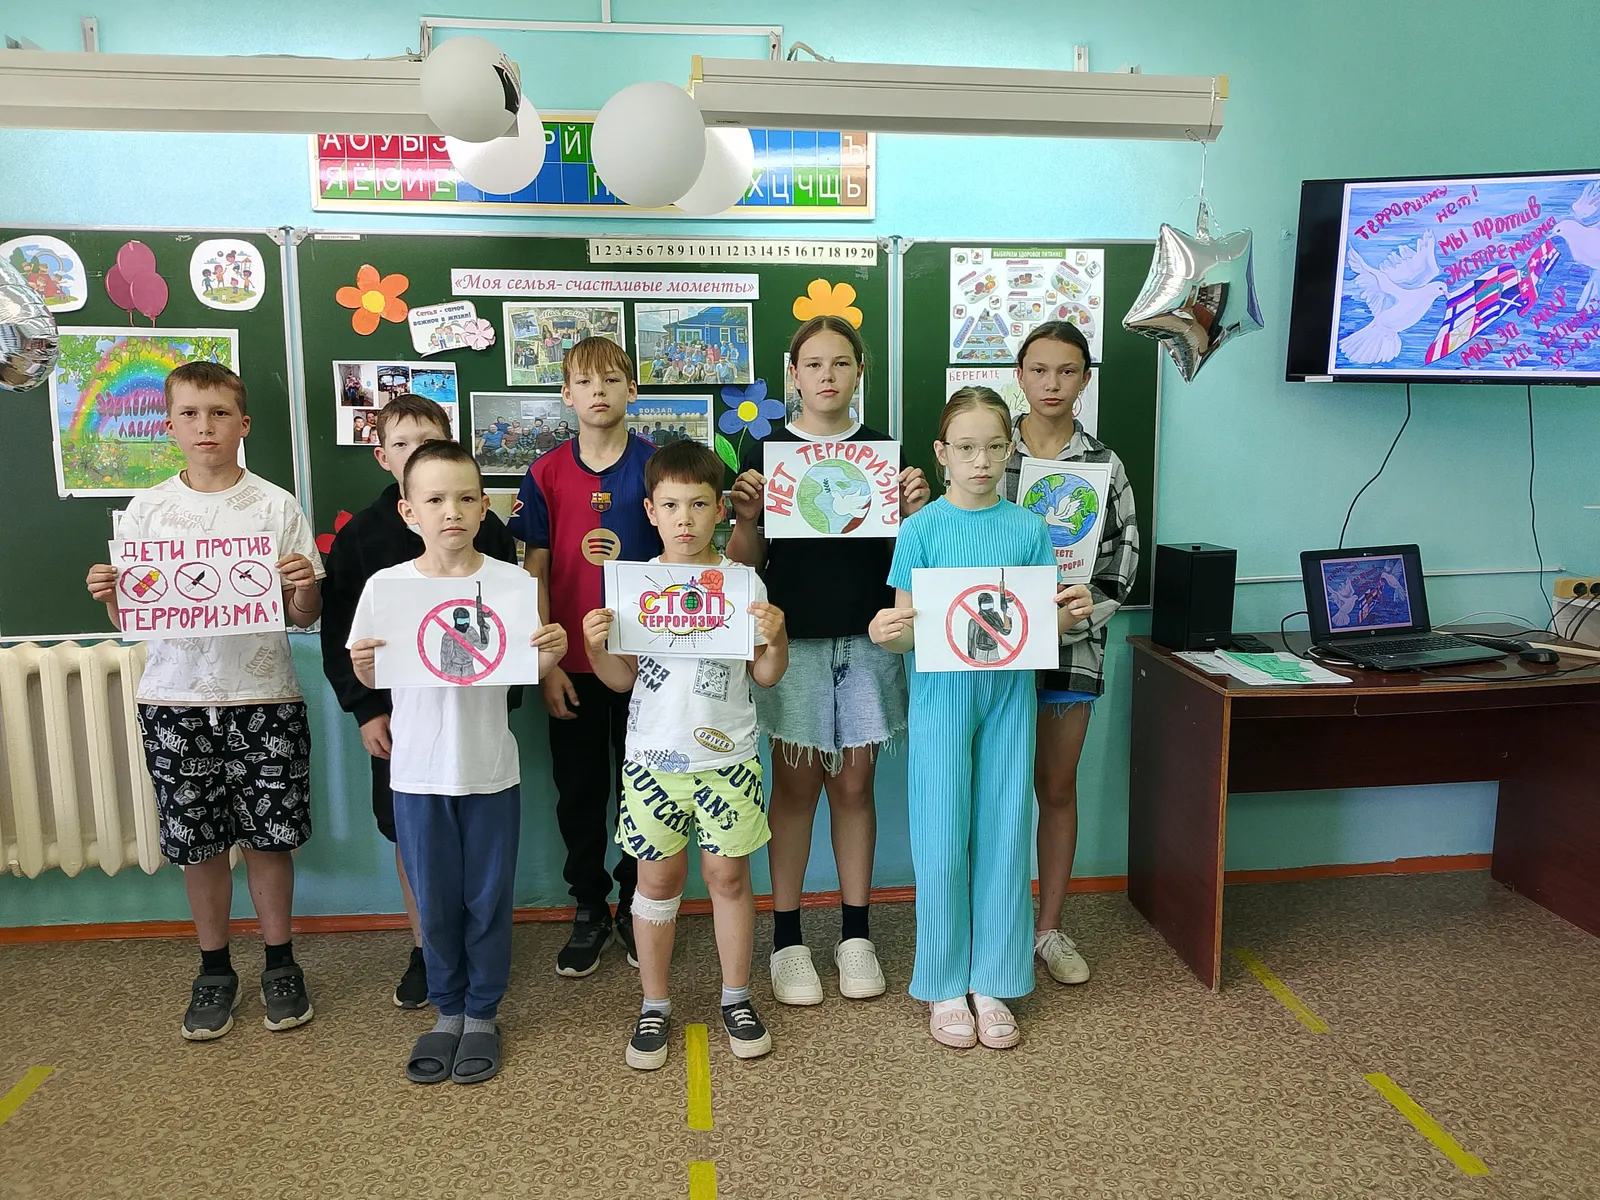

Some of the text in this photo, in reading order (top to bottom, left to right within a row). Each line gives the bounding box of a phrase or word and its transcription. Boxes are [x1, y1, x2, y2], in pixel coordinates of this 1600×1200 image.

[595, 245, 874, 258] 1 2 3 4 5 6 7 8 9 10 11 12 13 14 15 16 17 18 19 20
[566, 278, 662, 294] счастливые
[666, 280, 754, 296] моменты»
[950, 370, 999, 381] БЕРЕГИТЕ
[766, 462, 797, 516] НЕТ
[120, 536, 272, 562] ДЕТИ ПРОТИВ
[1056, 549, 1074, 557] ЕСТЕ
[1058, 559, 1084, 571] РРОРА!
[640, 591, 726, 614] СТОП
[119, 600, 279, 631] ТЕРРОРИЗМА!
[642, 615, 725, 628] ТЕРРОРИЗМУ
[639, 656, 670, 681] UPER
[700, 732, 730, 748] DRIVER
[255, 779, 286, 789] Music
